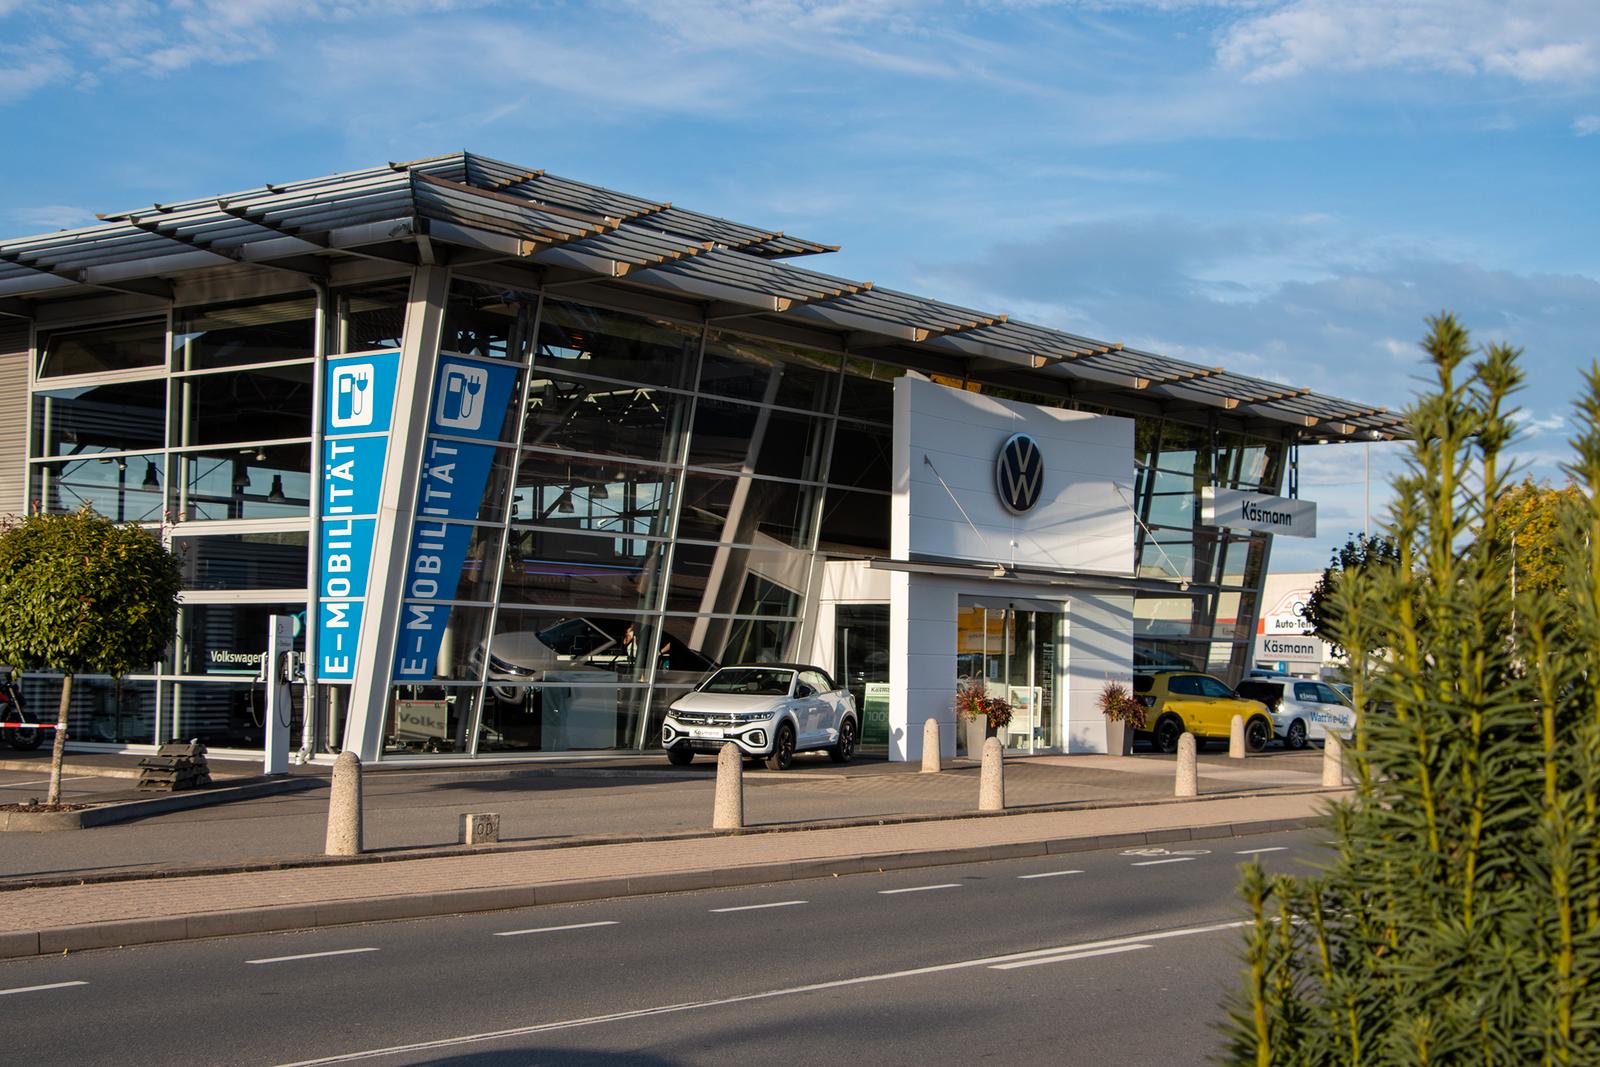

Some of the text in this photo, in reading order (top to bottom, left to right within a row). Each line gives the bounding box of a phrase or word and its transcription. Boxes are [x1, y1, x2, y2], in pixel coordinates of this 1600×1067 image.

[1242, 500, 1292, 526] Käsmann
[325, 441, 355, 673] E-MOBILITÄT
[400, 440, 458, 675] E-MOBILITÄT
[1264, 640, 1314, 654] Käsmann
[400, 712, 445, 730] Volks
